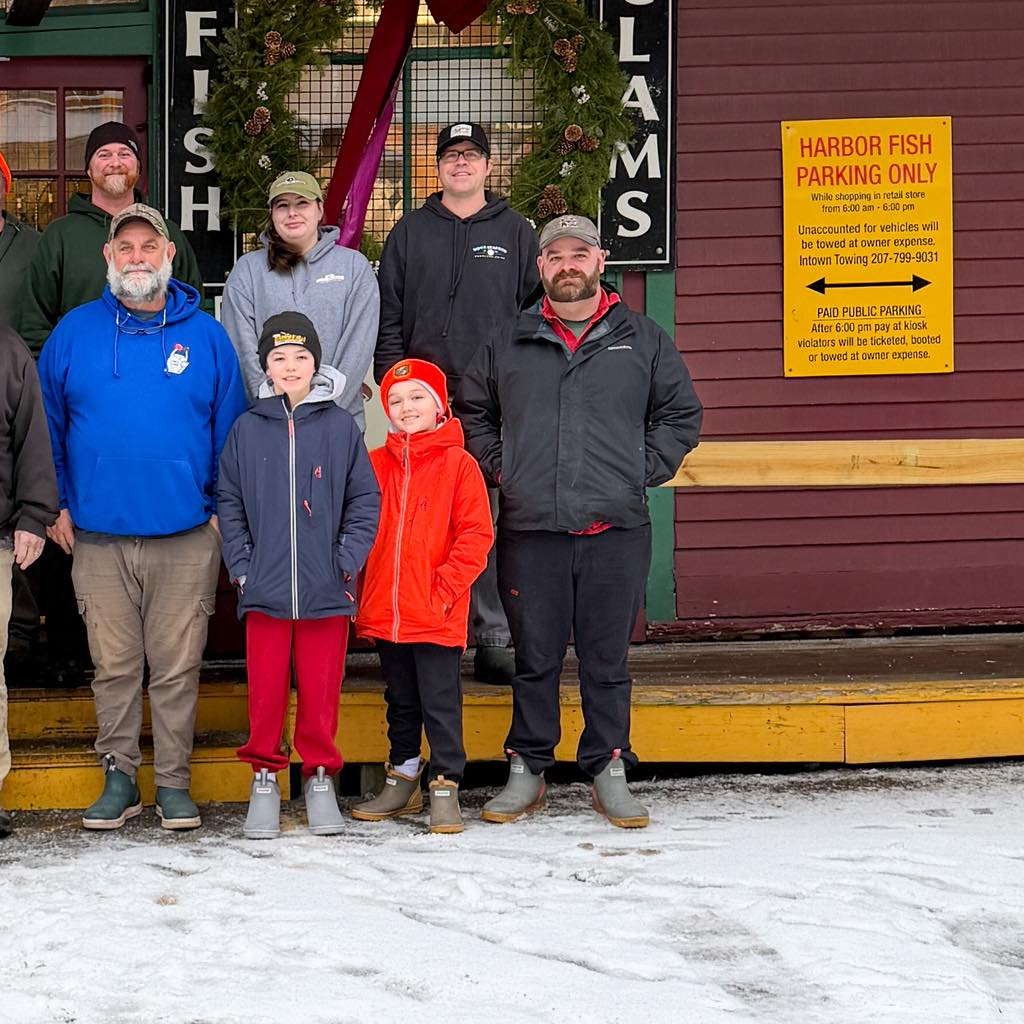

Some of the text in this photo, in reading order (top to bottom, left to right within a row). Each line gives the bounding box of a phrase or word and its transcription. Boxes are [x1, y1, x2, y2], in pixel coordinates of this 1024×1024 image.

[180, 11, 221, 231] FISH
[800, 134, 932, 158] HARBOR FISH
[797, 162, 937, 187] PARKING ONLY
[811, 190, 926, 202] While shopping in retail store
[822, 204, 840, 213] from
[842, 203, 860, 213] 6:00
[882, 203, 901, 212] 6:00
[902, 203, 915, 213] pm
[798, 221, 939, 235] Unaccounted for vehicles will
[801, 237, 936, 249] be towed at owner expense.
[799, 252, 939, 266] Intown Towing 207-799-9031
[817, 305, 922, 318] PAID PUBLIC PARKING
[811, 320, 928, 333] After 6:00 pm pay at kiosk
[798, 334, 941, 348] violators will be ticketed, booted
[808, 350, 930, 362] or towed at owner expense.
